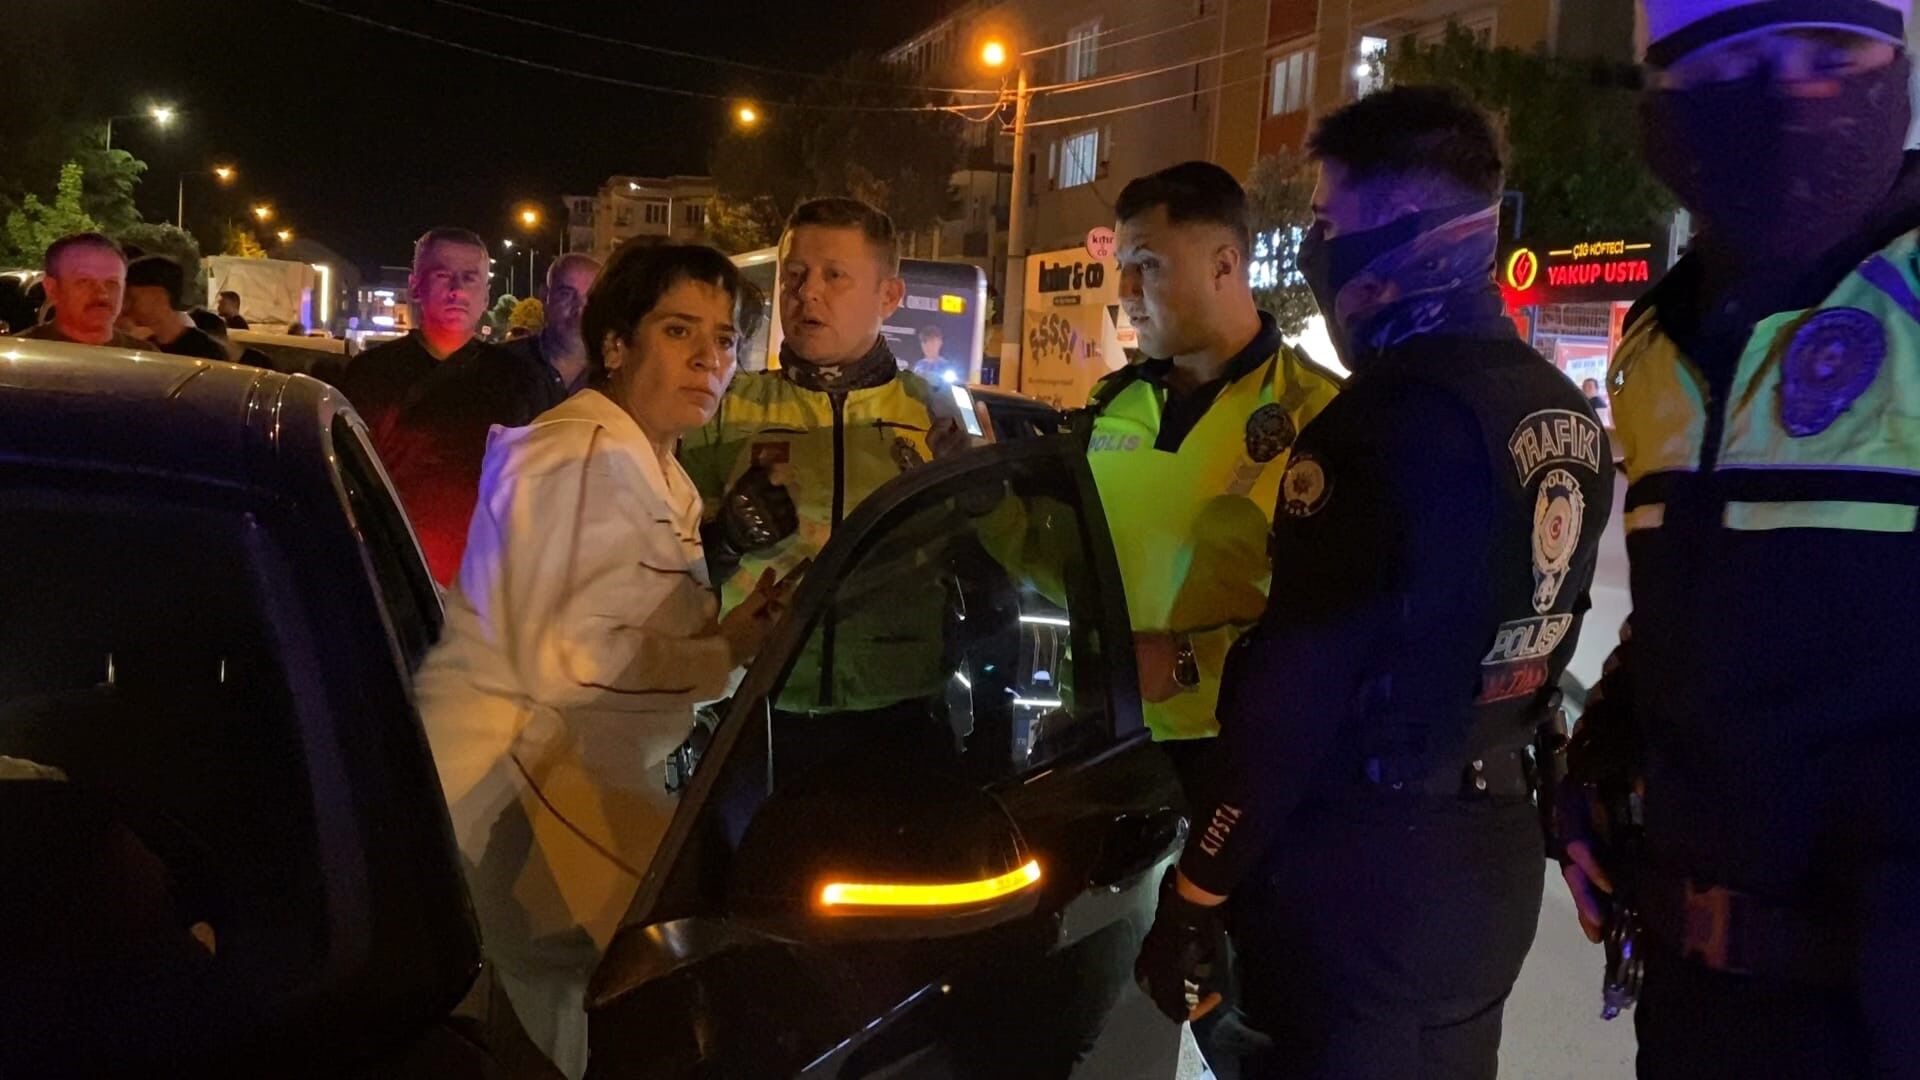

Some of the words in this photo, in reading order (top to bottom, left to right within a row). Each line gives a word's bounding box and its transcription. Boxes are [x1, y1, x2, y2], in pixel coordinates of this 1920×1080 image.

[1548, 266, 1601, 286] YAKUP
[1604, 261, 1649, 282] USTA
[1199, 802, 1243, 857] KIPSTA
